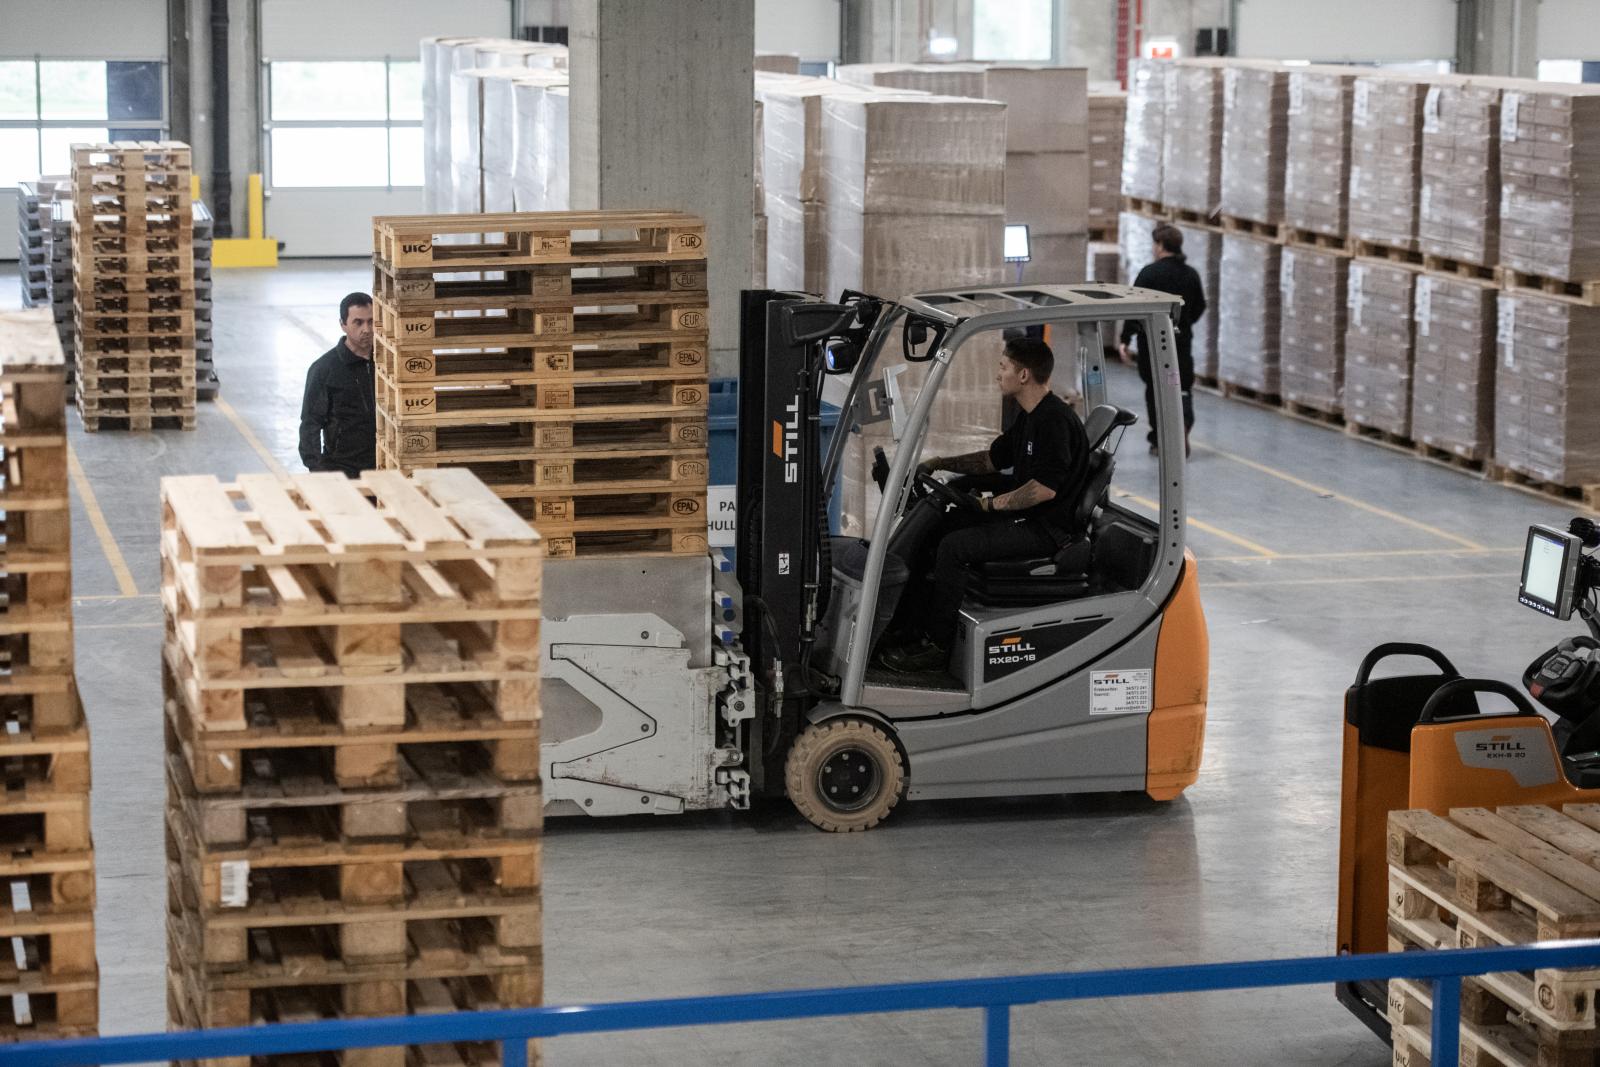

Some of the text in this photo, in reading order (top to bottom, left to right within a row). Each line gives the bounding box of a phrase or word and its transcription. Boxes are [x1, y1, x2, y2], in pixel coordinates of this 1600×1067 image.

[680, 236, 696, 247] EUR
[684, 314, 700, 326] EUR
[679, 353, 695, 362] EPAL
[409, 361, 427, 370] EPAL
[681, 391, 696, 401] EUR
[785, 394, 799, 483] STILL
[677, 502, 697, 512] EPAL
[989, 643, 1036, 654] STILL
[1476, 742, 1526, 751] STILL
